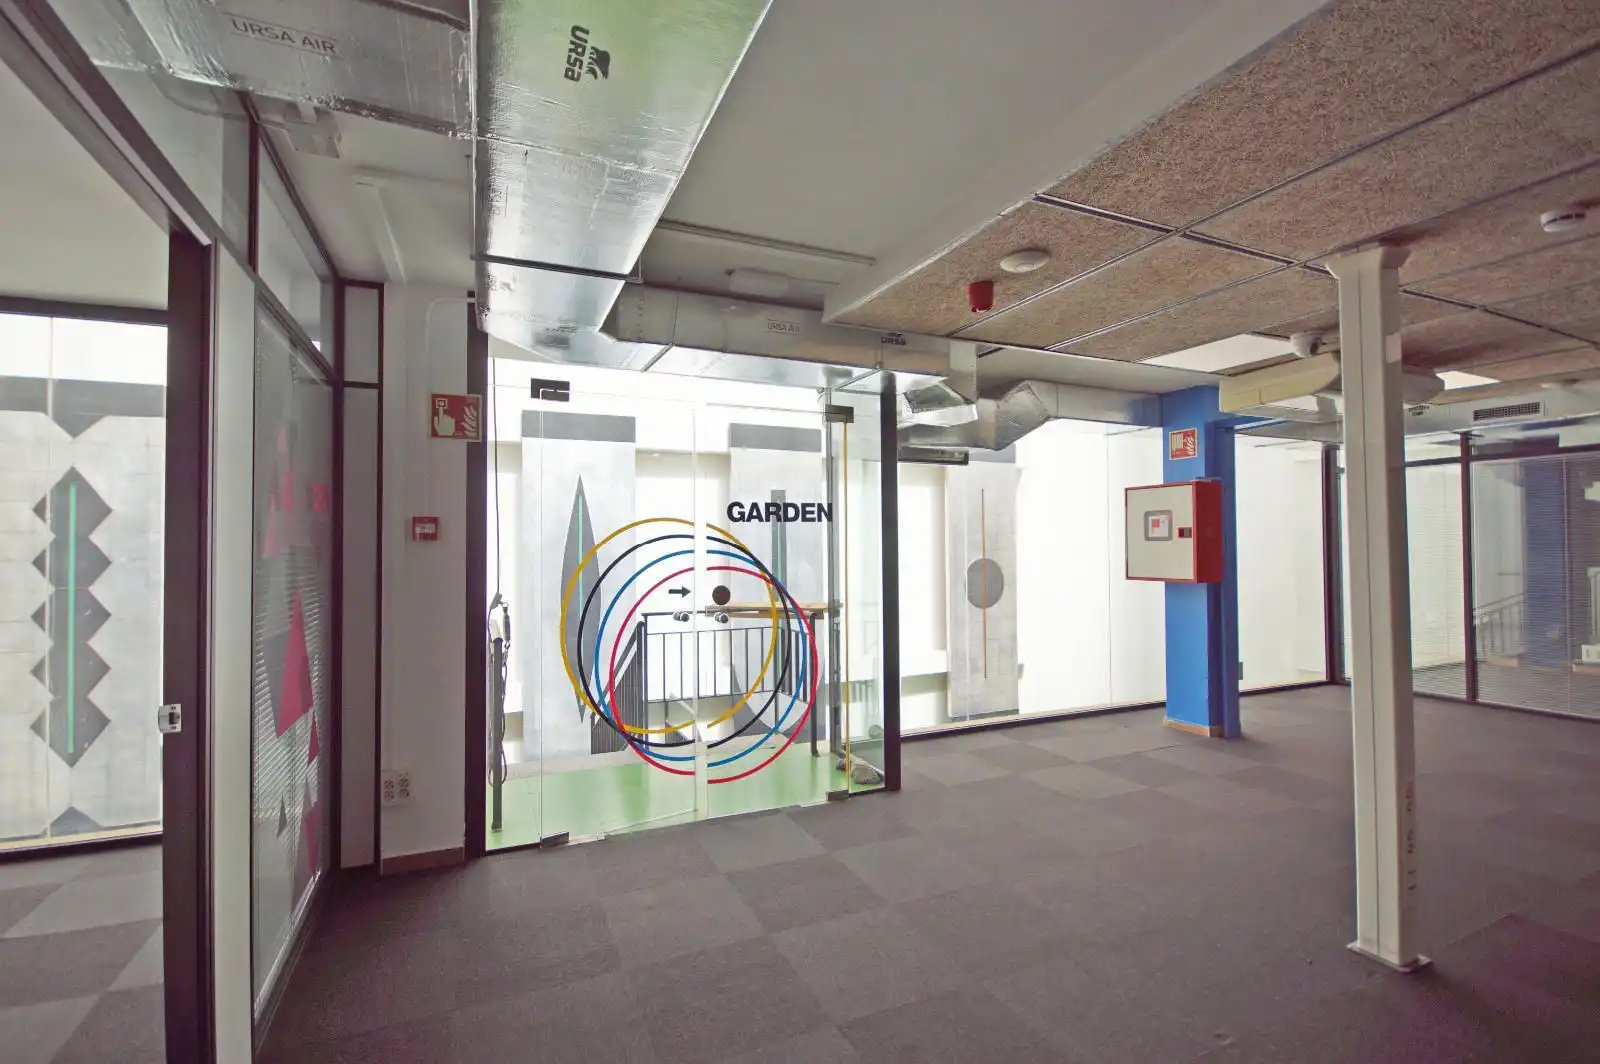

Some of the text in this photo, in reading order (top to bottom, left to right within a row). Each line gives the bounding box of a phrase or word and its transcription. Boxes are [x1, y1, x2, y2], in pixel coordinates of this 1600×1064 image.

[231, 18, 336, 54] URSA AIR
[726, 501, 833, 523] GARDEN
